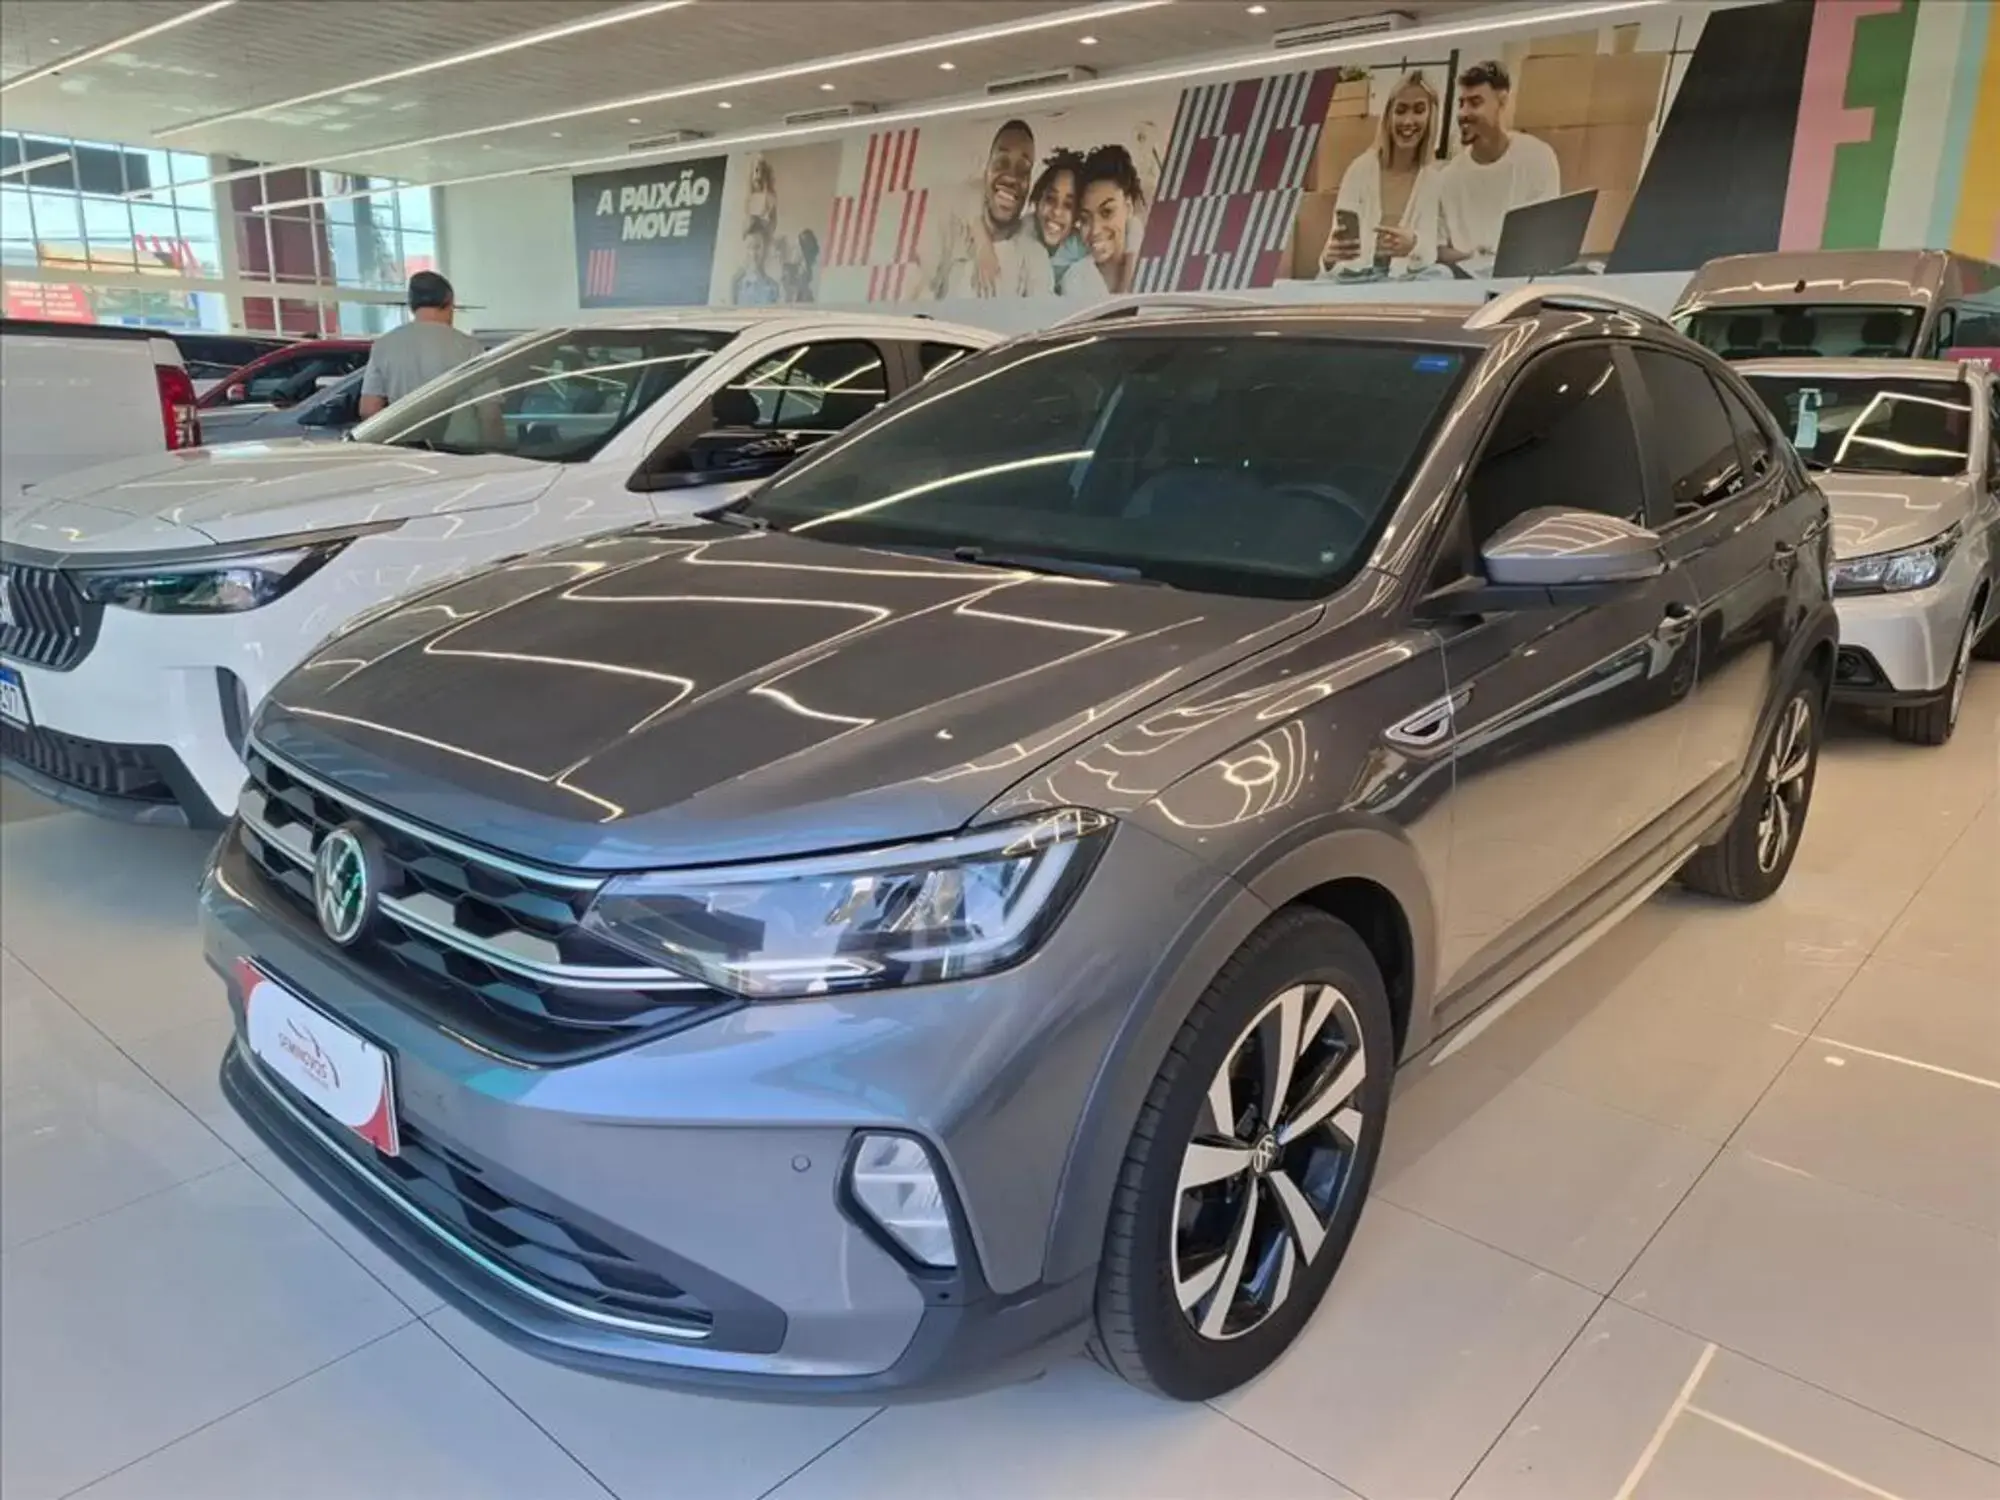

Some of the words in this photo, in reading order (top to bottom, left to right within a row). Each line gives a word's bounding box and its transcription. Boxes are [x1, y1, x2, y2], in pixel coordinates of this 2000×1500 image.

[596, 189, 613, 216] A
[620, 169, 710, 214] PAIXÃO
[621, 209, 692, 241] MOVE
